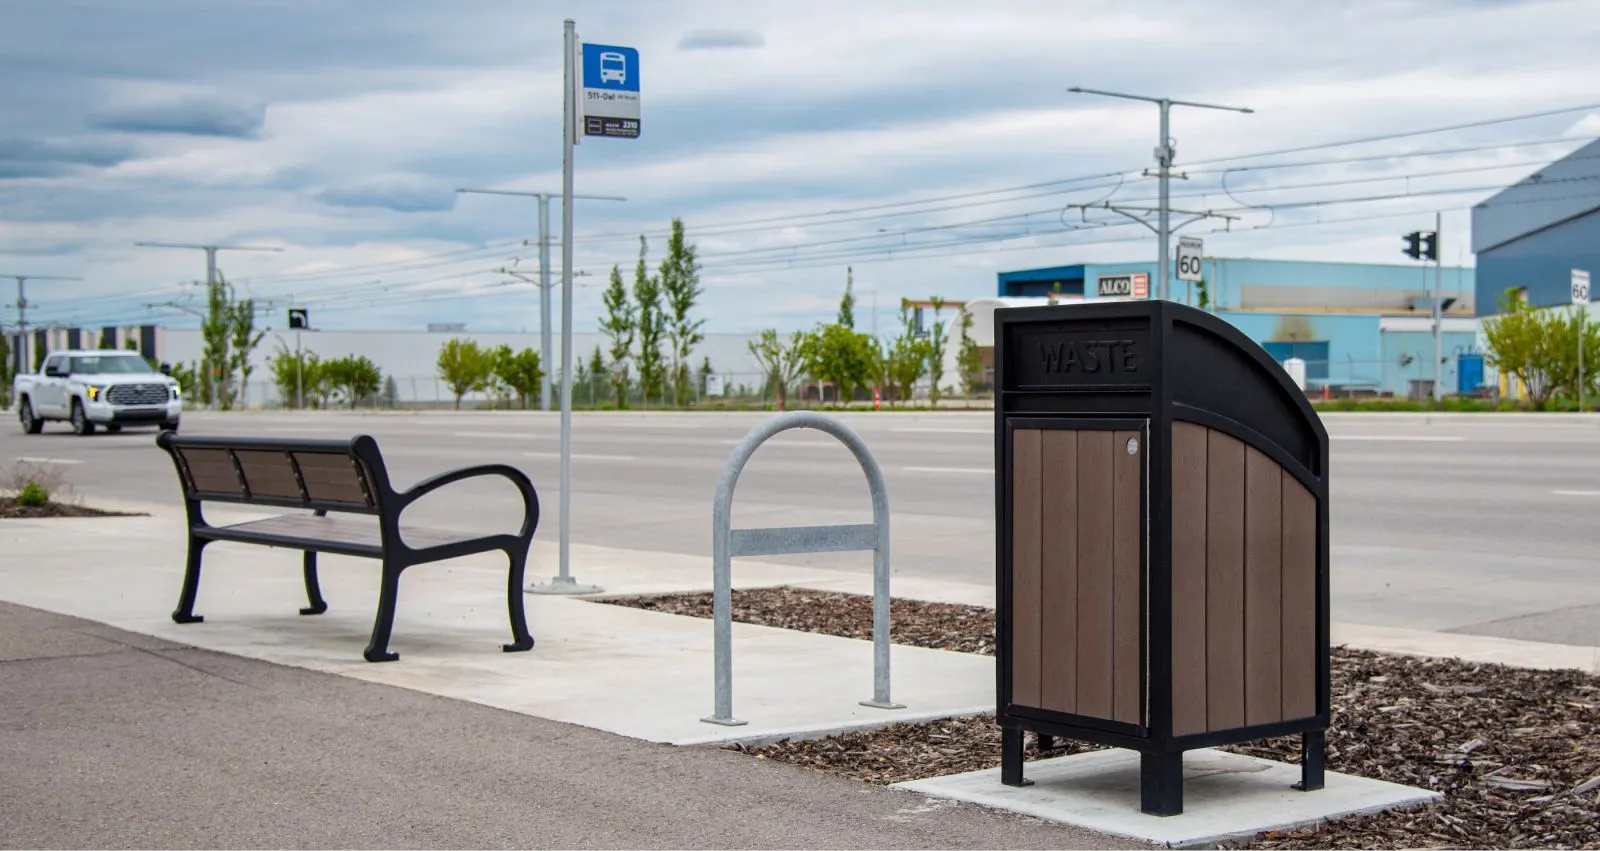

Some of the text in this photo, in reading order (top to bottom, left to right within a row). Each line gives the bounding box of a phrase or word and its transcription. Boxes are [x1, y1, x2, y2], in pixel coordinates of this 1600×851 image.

[587, 91, 615, 101] 511-Owl
[1180, 255, 1200, 275] 60
[1099, 278, 1130, 295] ALCO
[1572, 283, 1588, 300] 60
[1037, 339, 1138, 374] WASTE
